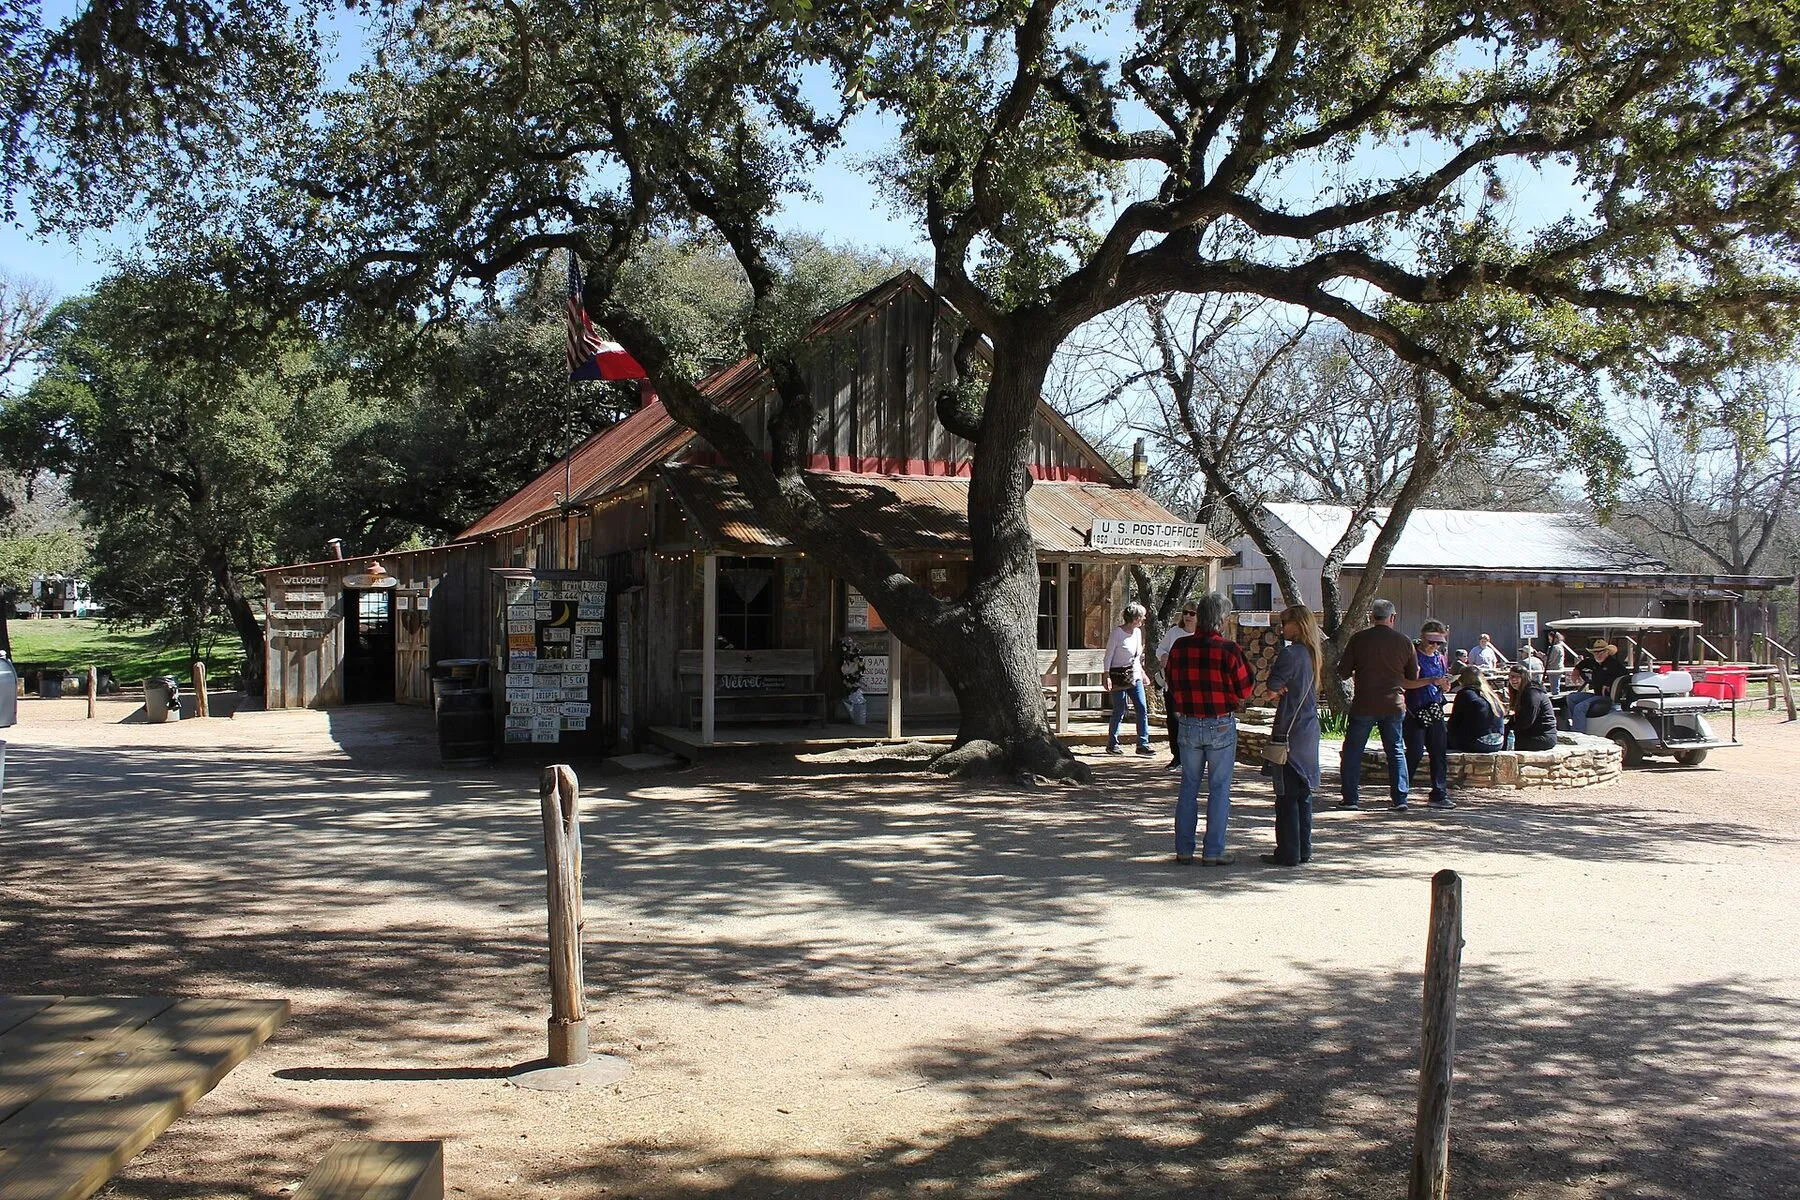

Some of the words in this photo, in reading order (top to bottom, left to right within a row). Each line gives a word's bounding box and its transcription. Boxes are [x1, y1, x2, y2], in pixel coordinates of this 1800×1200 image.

[1101, 521, 1113, 534] U.
[1117, 522, 1128, 534] S.
[281, 576, 325, 584] WELCOME!
[510, 624, 527, 633] RILEY
[580, 626, 600, 634] PERICO
[873, 658, 885, 666] AM
